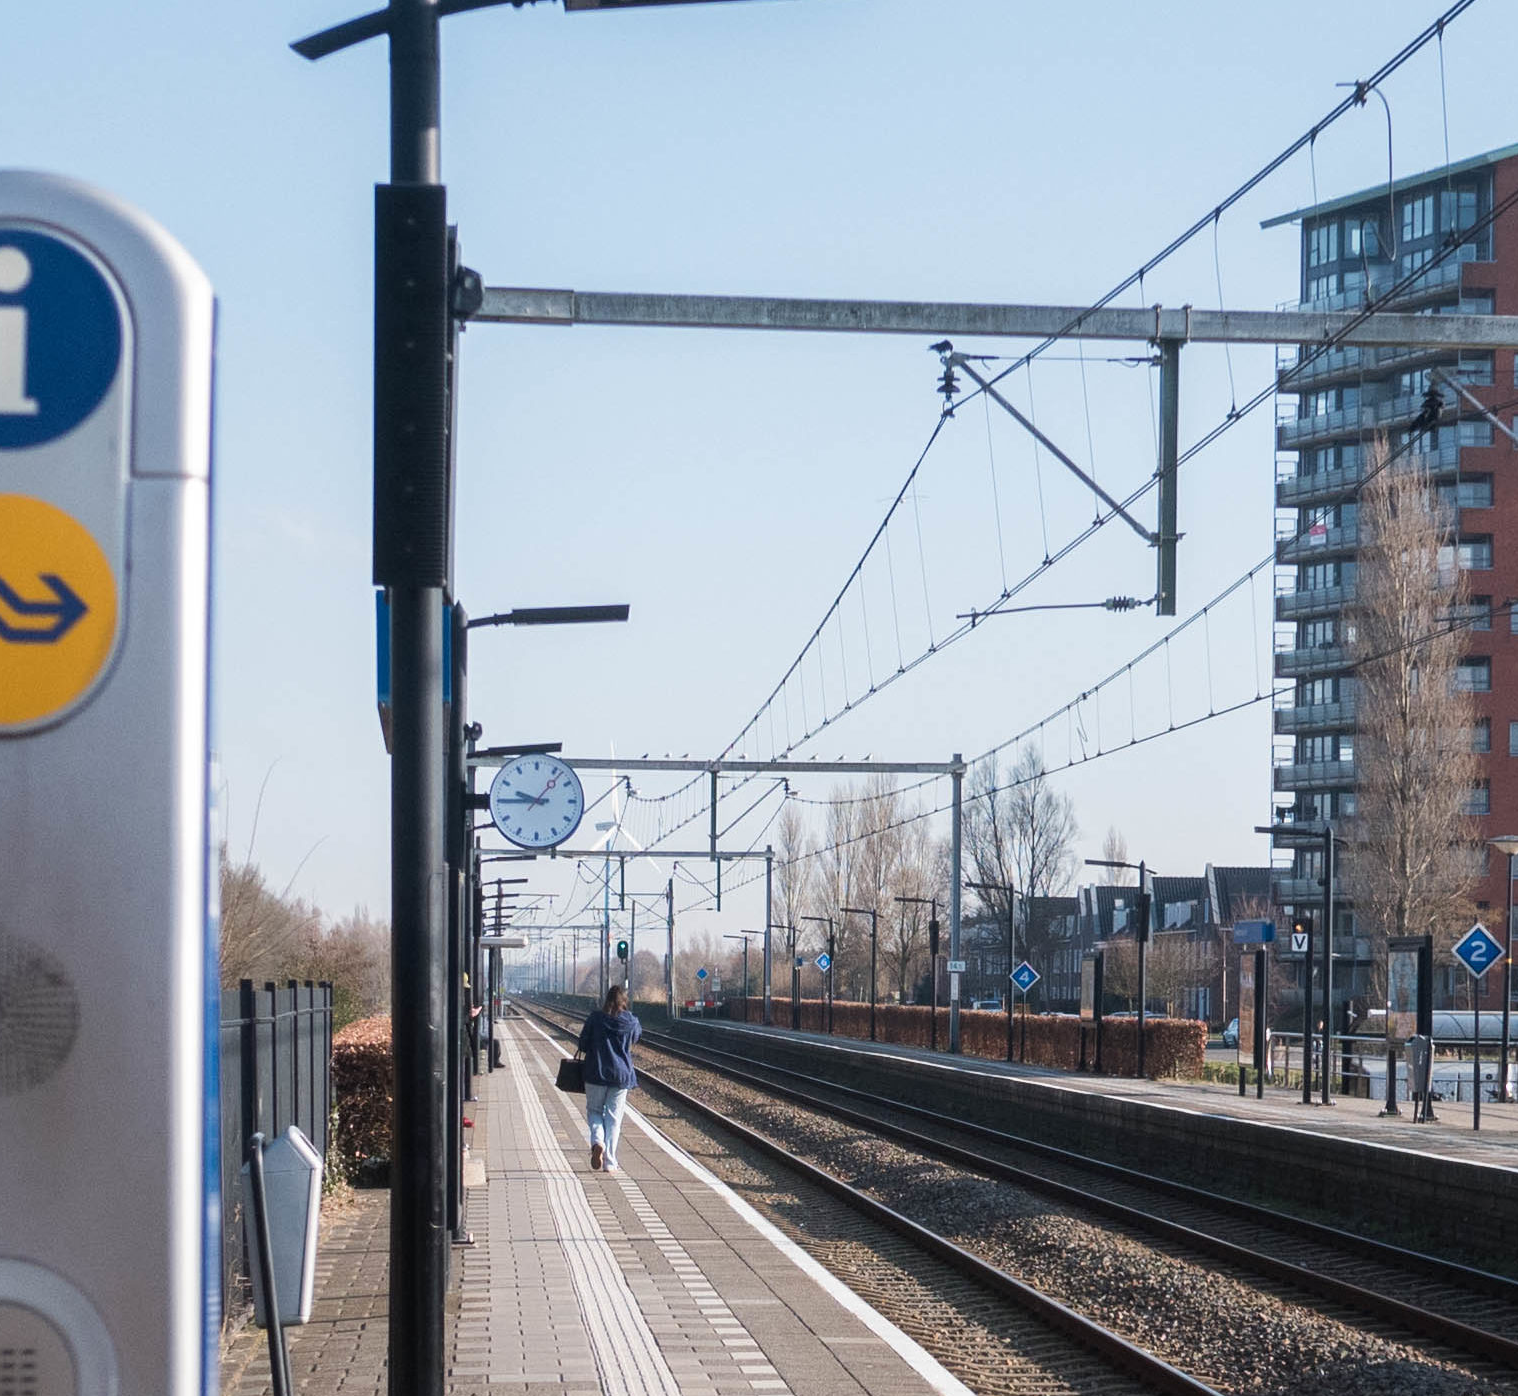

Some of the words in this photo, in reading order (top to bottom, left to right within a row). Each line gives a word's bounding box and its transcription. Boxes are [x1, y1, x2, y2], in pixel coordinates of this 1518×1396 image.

[1293, 935, 1306, 949] V
[1470, 940, 1486, 961] 2
[1018, 971, 1029, 982] 4
